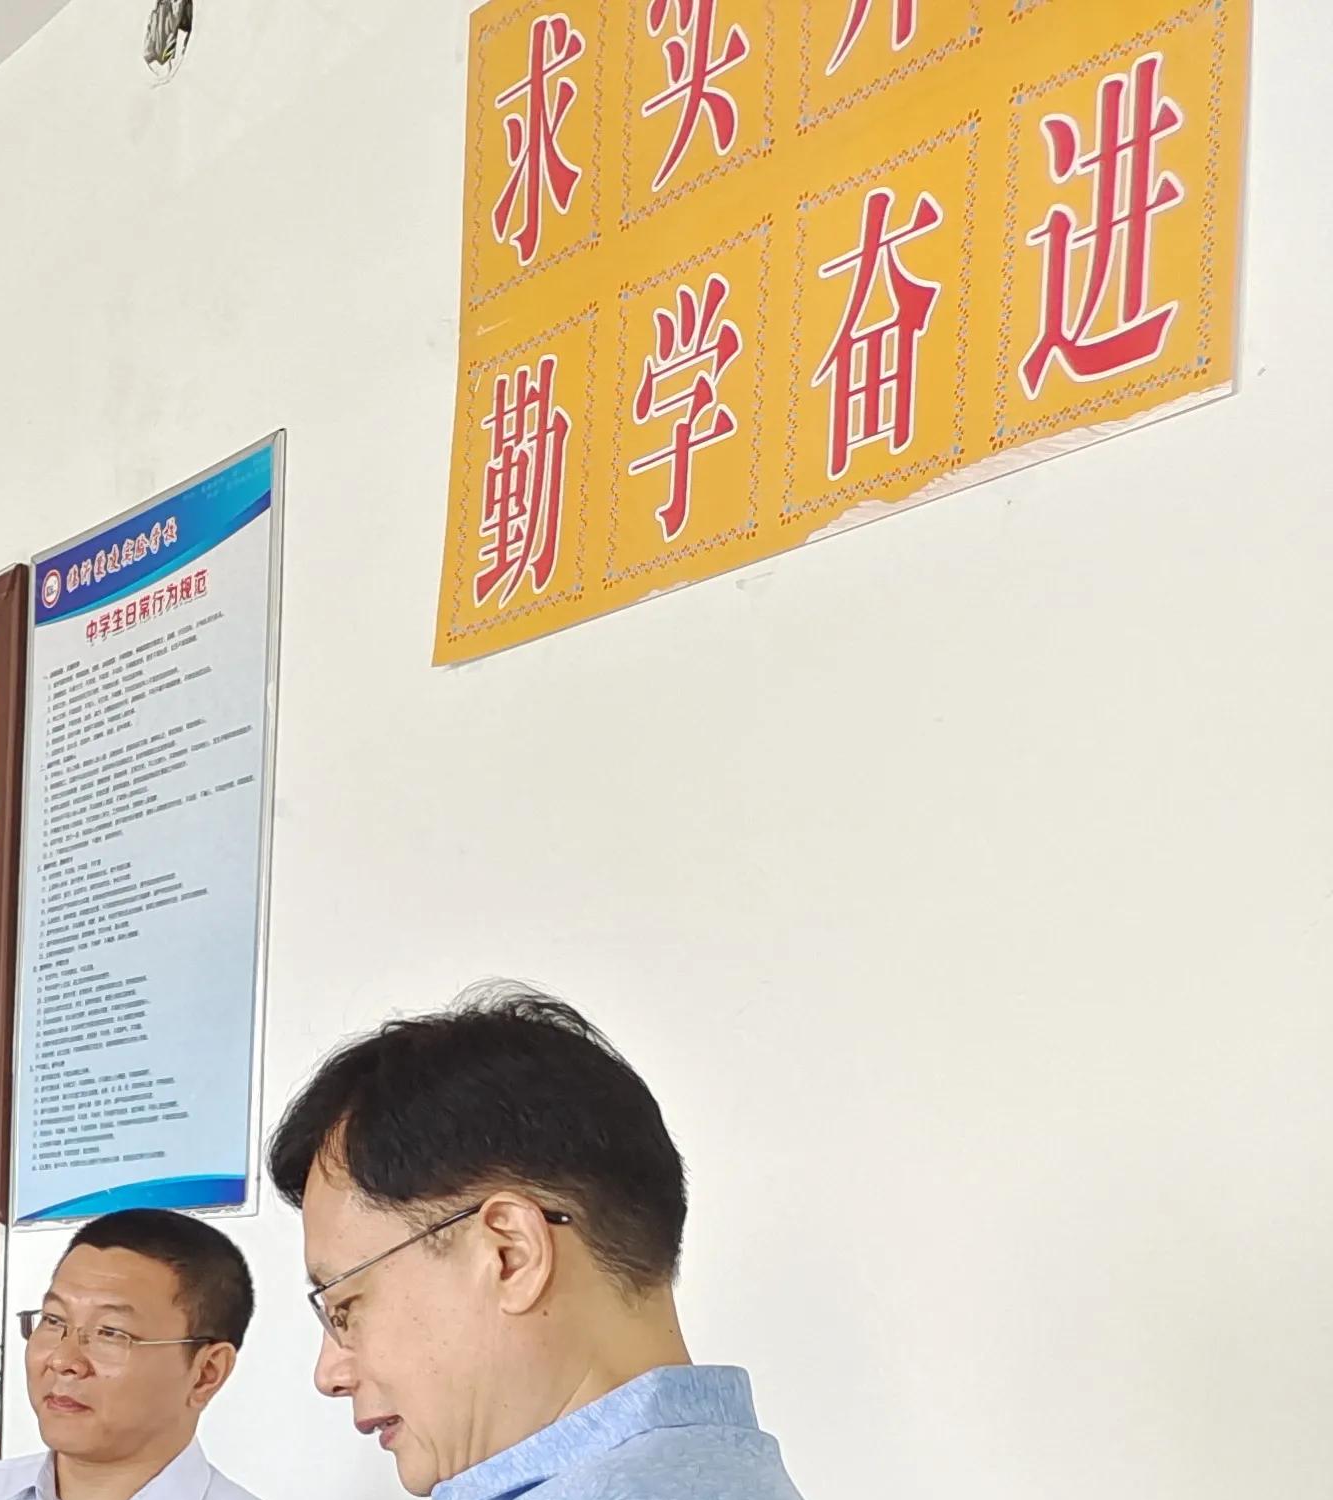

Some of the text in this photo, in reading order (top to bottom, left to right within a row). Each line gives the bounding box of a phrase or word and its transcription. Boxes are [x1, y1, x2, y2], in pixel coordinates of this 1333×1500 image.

[474, 51, 1184, 609] 勤学奋进
[85, 568, 210, 643] 中学生日常行为规范
